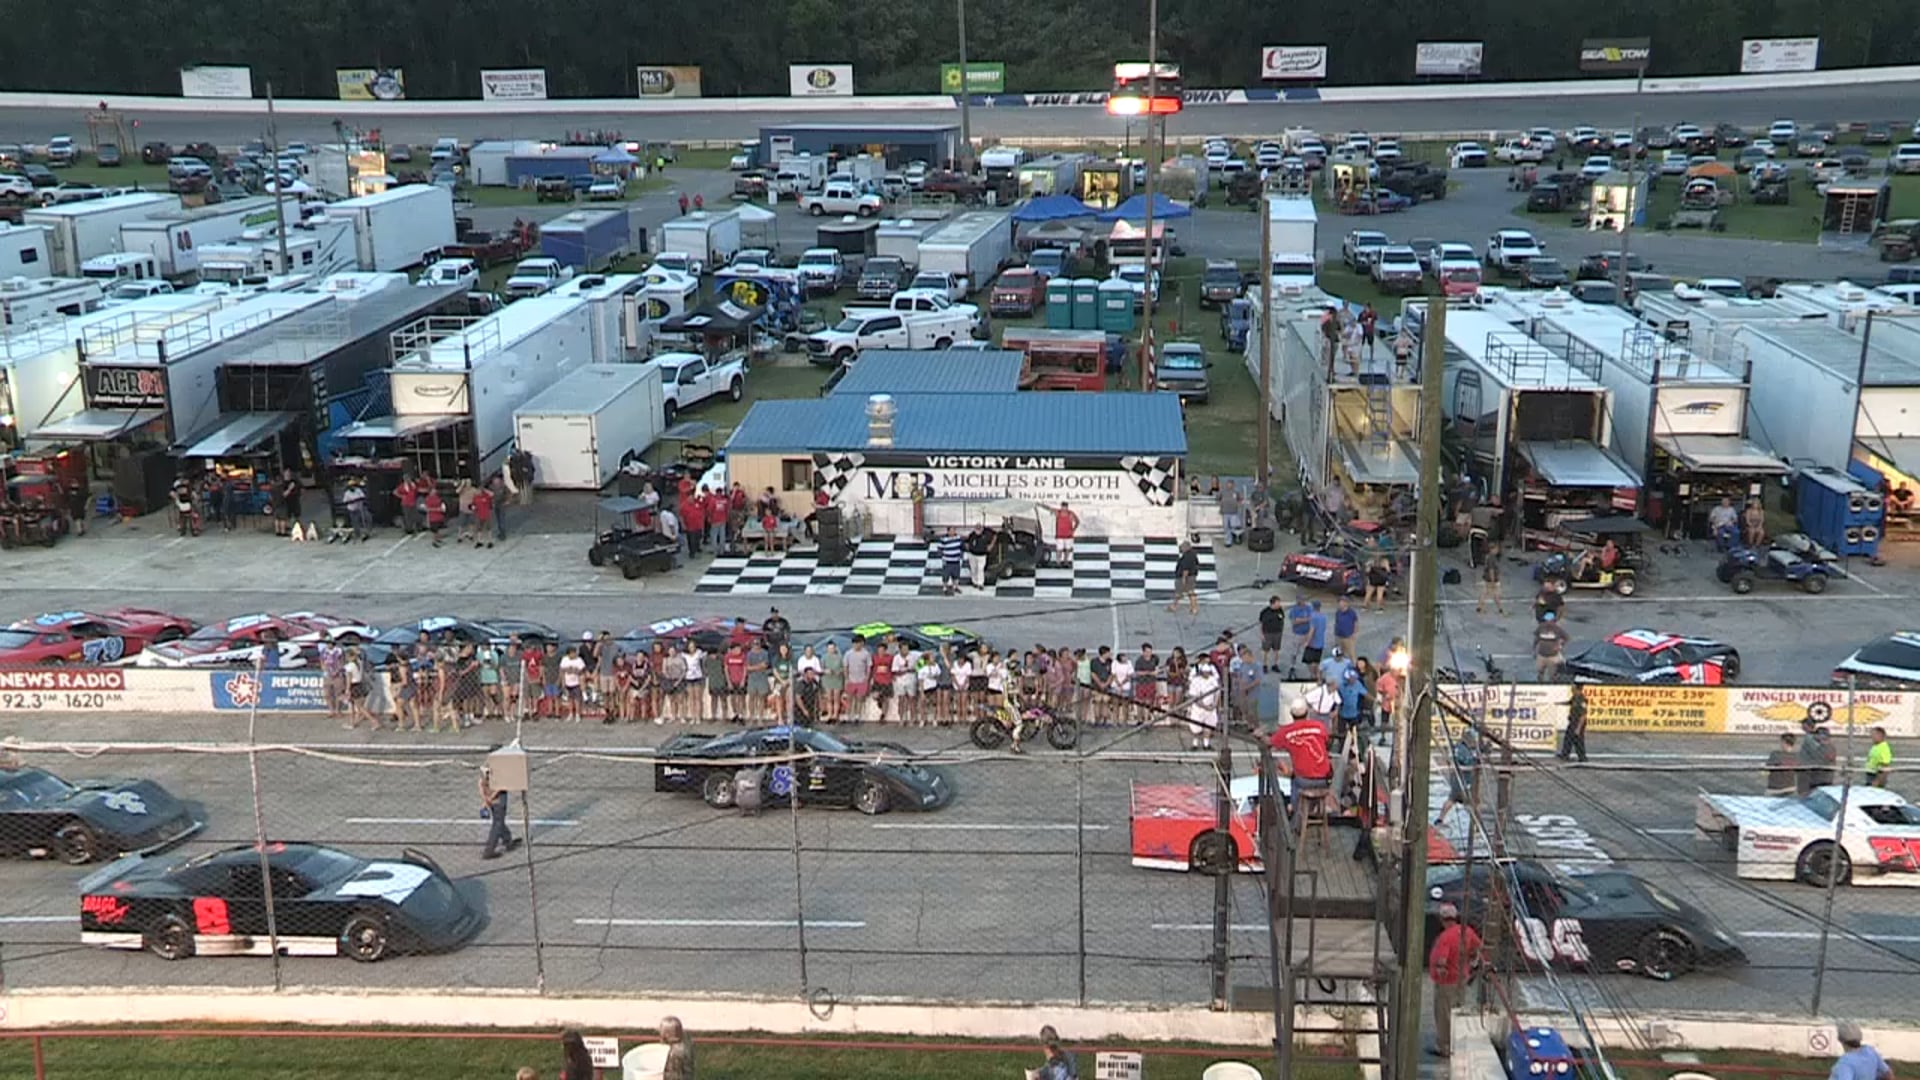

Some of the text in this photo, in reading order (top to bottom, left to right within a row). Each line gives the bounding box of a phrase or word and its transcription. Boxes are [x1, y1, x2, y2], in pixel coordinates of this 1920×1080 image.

[1621, 49, 1649, 59] TOW
[1033, 95, 1072, 104] FIVE
[926, 456, 1065, 469] VICTORY LANE
[943, 474, 1028, 489] MICHLES
[1034, 476, 1047, 487] &
[1053, 475, 1119, 489] BOOTH
[942, 490, 1000, 499] ACCIDENT
[1019, 491, 1060, 500] INJURY
[1066, 491, 1120, 500] LAWYERS
[0, 673, 121, 688] NEWS RADIO
[1609, 688, 1677, 699] SYNTHETIC
[1743, 691, 1796, 701] WINGED
[1798, 692, 1844, 703] WHEEL
[4, 693, 42, 709] 92.3
[66, 693, 104, 708] 1620
[1599, 698, 1651, 707] CHANGE
[1626, 718, 1649, 727] TIRE
[1663, 719, 1705, 728] SERVICE
[1510, 728, 1553, 740] SHOP
[1107, 1061, 1119, 1069] NOT
